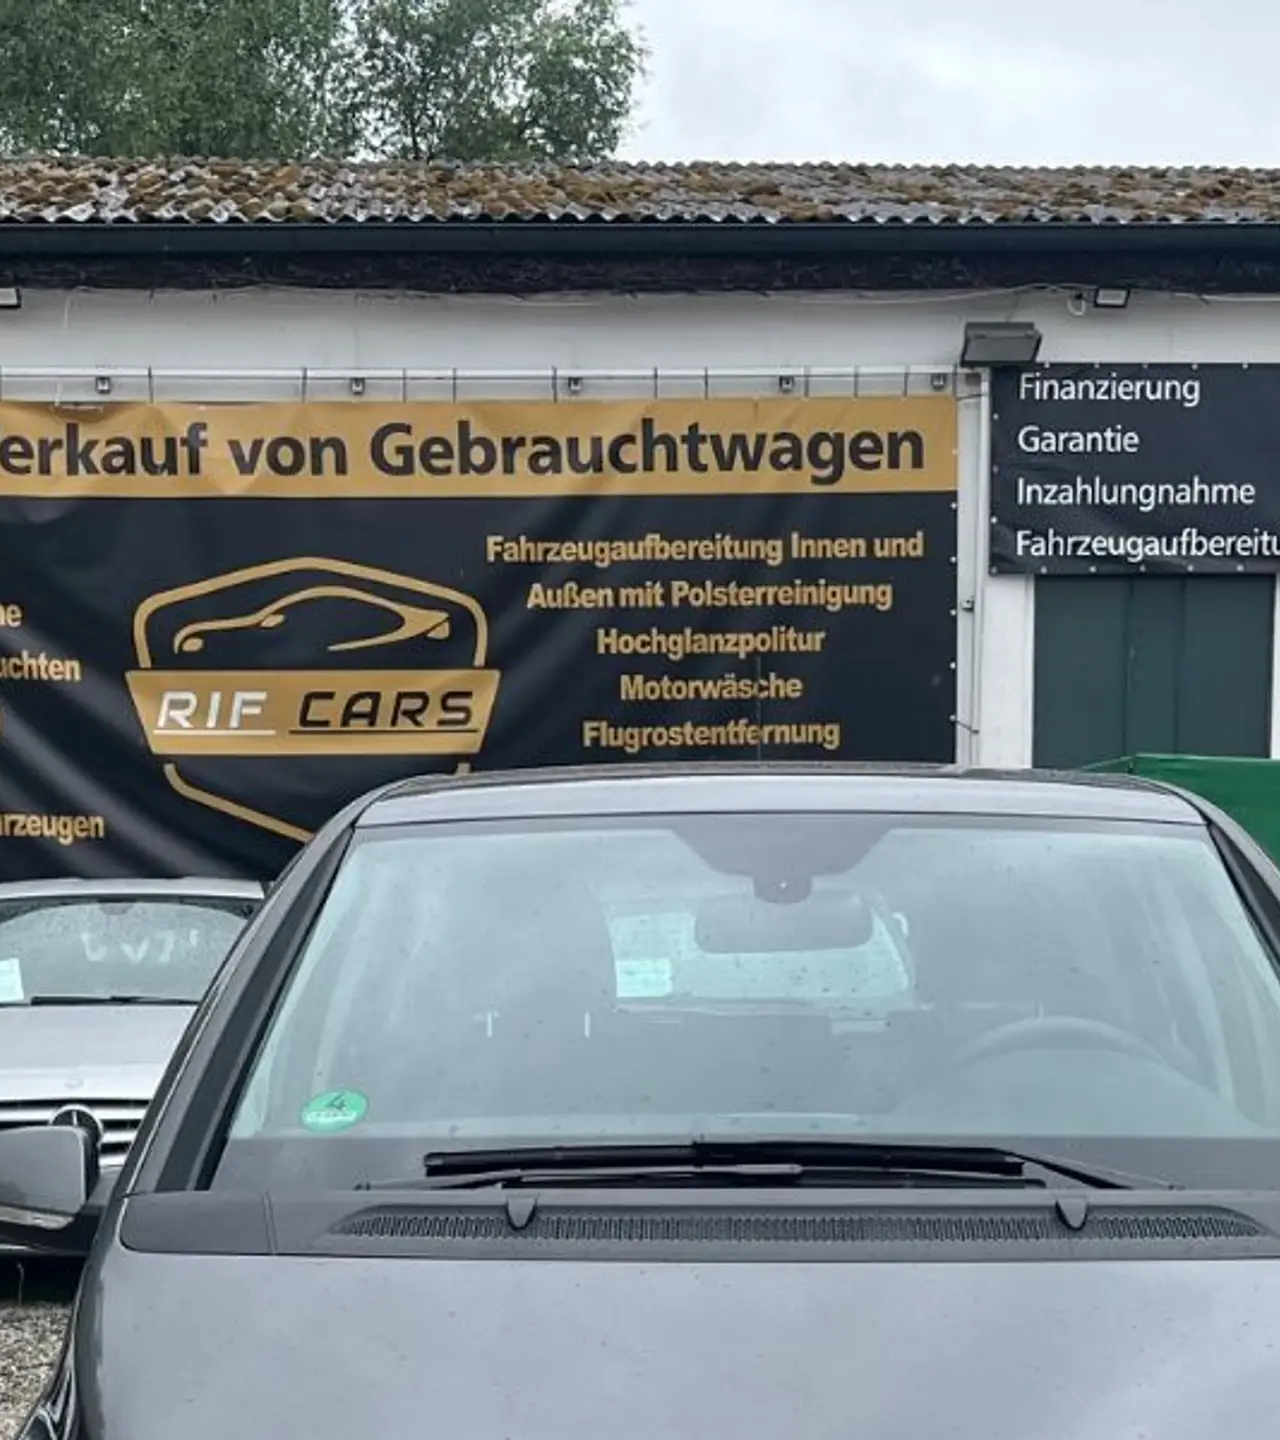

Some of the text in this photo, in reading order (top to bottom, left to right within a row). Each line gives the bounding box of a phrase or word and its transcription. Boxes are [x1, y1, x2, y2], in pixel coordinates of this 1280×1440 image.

[1019, 374, 1200, 407] Finanzierung
[230, 435, 347, 476] von
[370, 417, 924, 485] Gebrauchtwagen
[1018, 426, 1139, 454] Garantie
[1017, 478, 1255, 512] Inzahlungnahme
[486, 531, 923, 567] Fahrzeugaufbereitung Innen und
[527, 579, 892, 611] Außen mit Polsterreinigung
[597, 627, 825, 658] Hochglanzpolitur
[620, 673, 802, 701] Motorwäsche
[156, 690, 473, 729] RIF CARS
[582, 720, 841, 753] Flugrostentfernung
